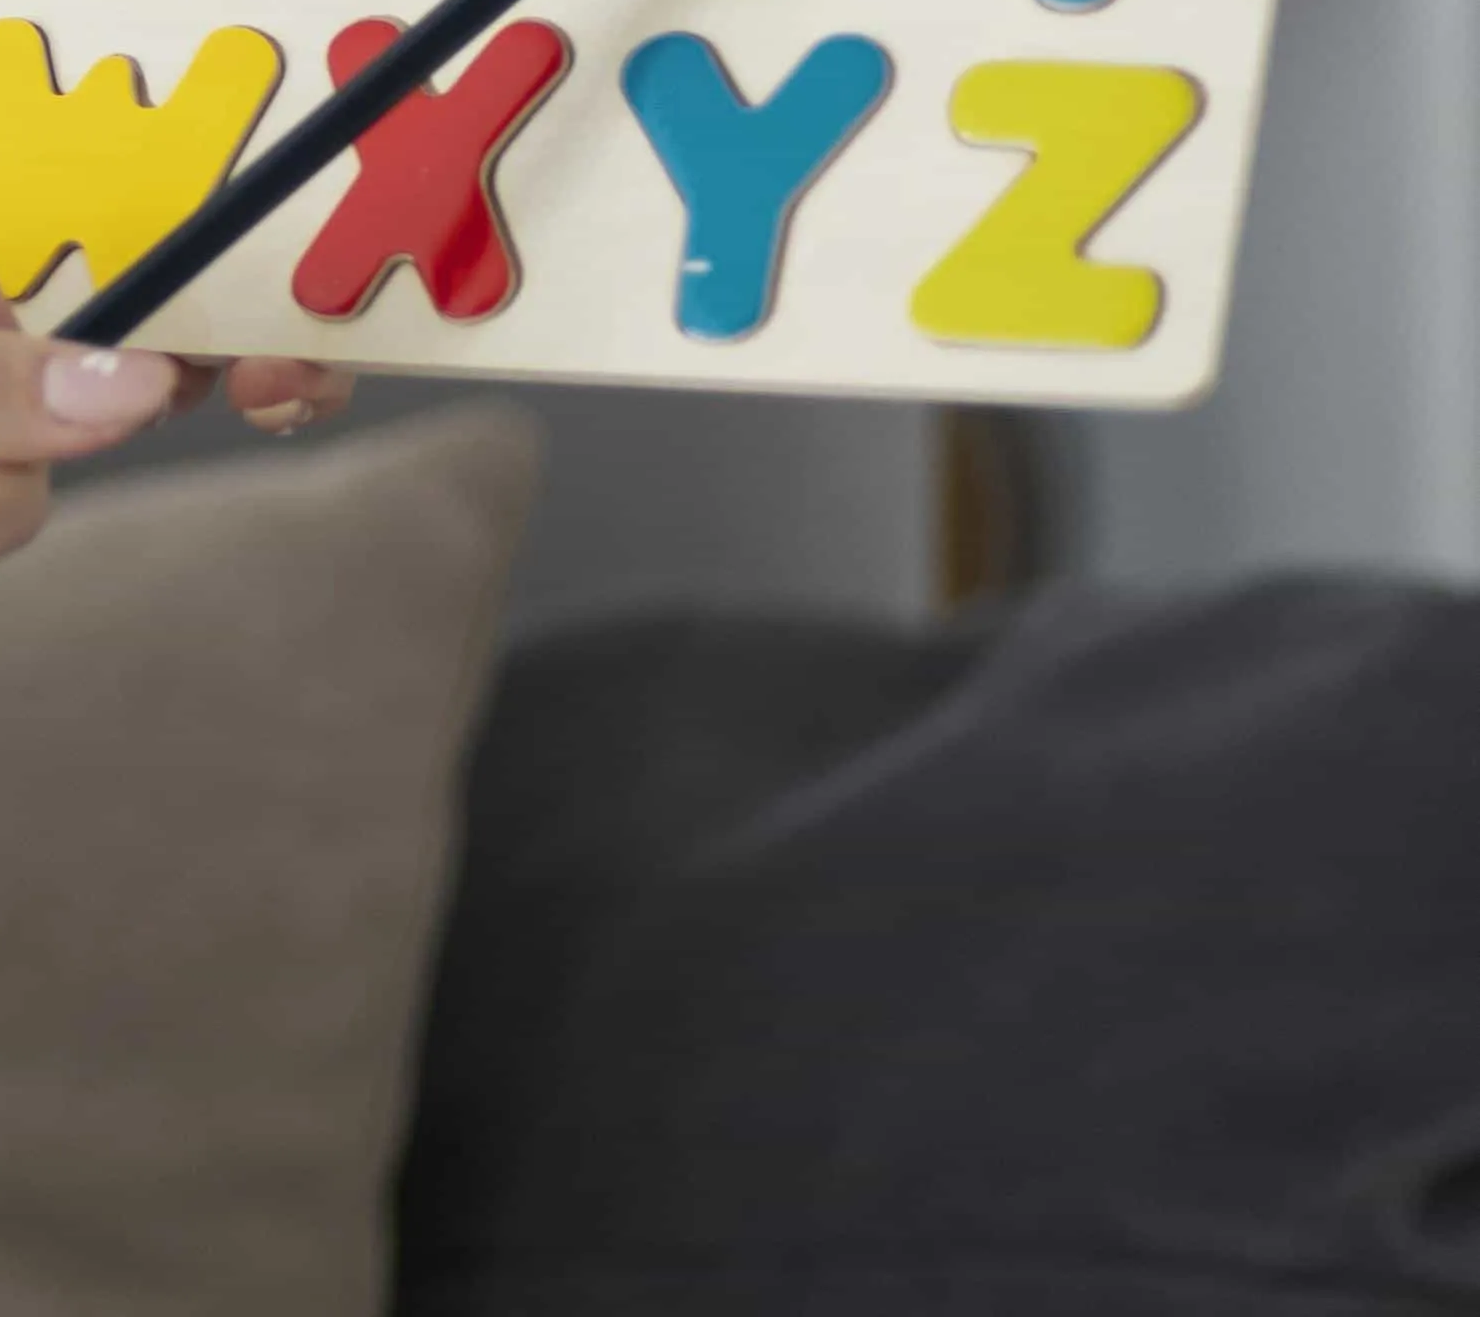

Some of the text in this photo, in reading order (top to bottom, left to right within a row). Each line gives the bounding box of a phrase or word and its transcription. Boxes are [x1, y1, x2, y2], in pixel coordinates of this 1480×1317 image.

[292, 17, 571, 322] X
[623, 34, 889, 340] Y
[911, 61, 1204, 348] Z
